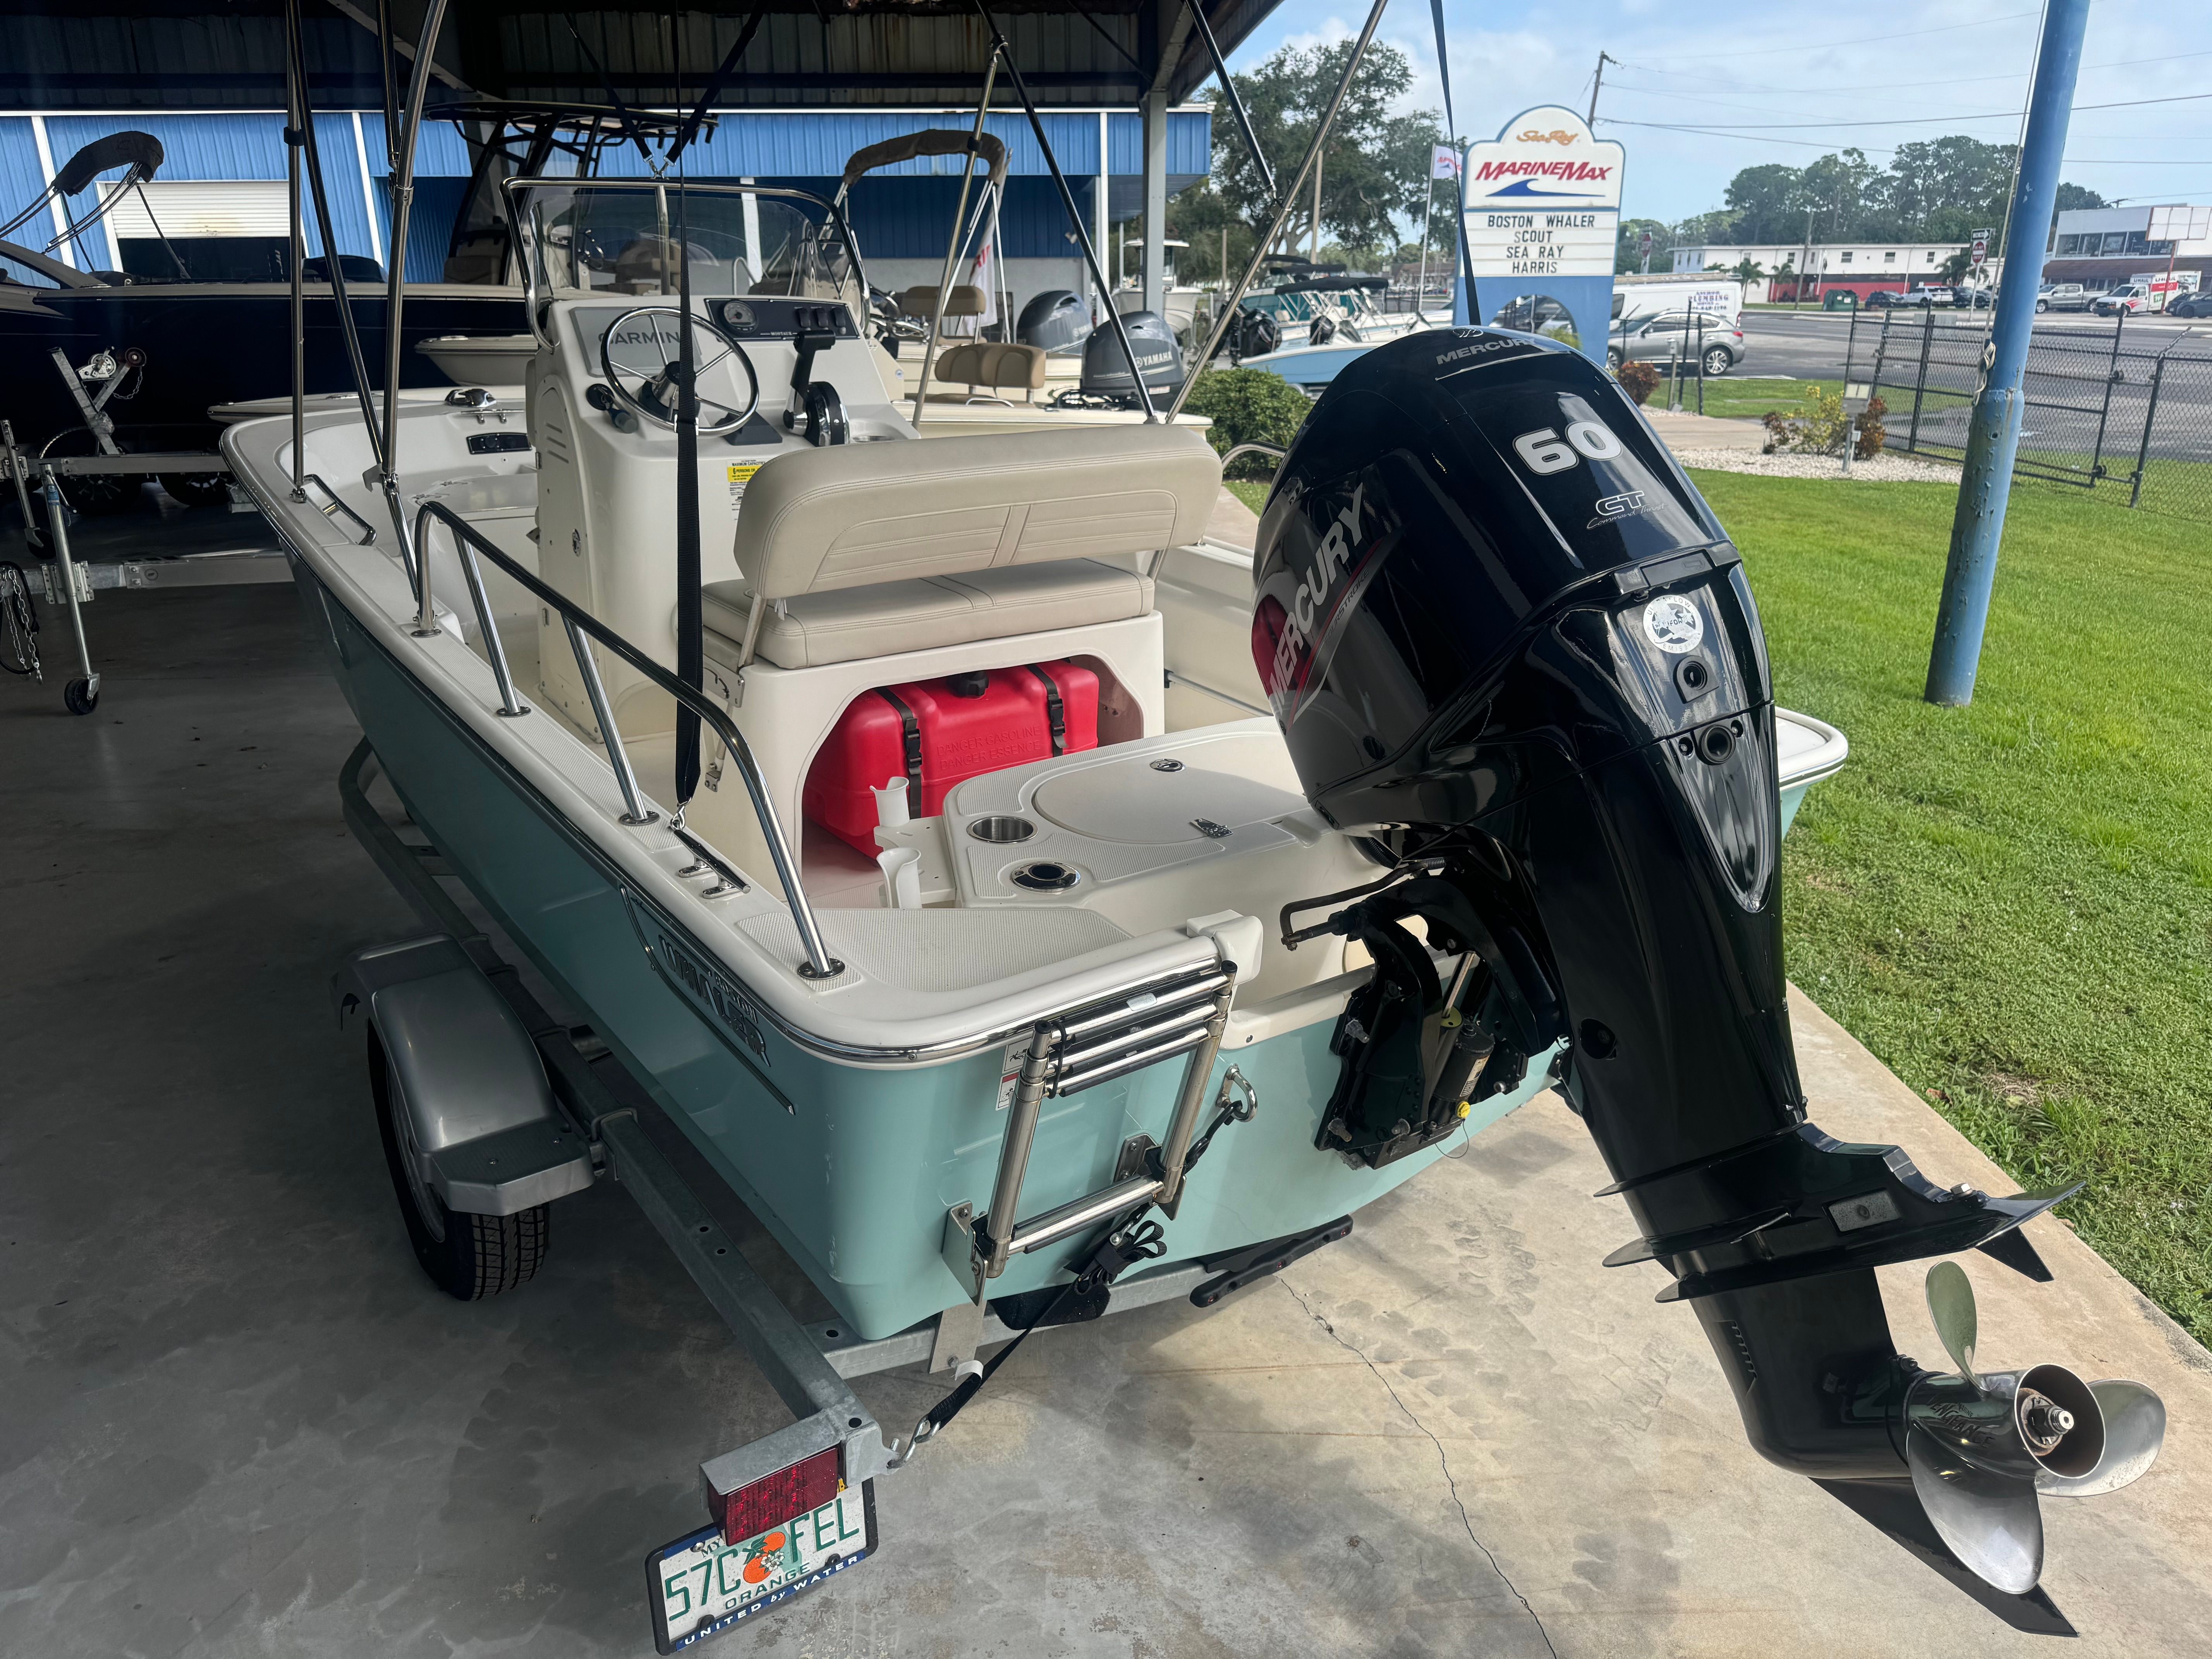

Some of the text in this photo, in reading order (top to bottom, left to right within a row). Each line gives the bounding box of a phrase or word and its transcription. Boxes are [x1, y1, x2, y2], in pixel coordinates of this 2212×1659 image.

[1488, 215, 1595, 228] BOSTON WHALER
[1514, 231, 1553, 243] SCOUT
[1506, 246, 1564, 258] SEA RAY
[1512, 261, 1557, 273] HARRIS
[1143, 351, 1173, 366] YAMAHA
[1436, 338, 1535, 364] MERCURY
[1513, 420, 1623, 475] 60
[1587, 503, 1665, 530] Command Thrust
[1595, 490, 1645, 516] CT
[1269, 482, 1364, 713] MERCURY
[937, 726, 1041, 756] DANGER GASOLINE
[940, 740, 1041, 771] DANGER ESSENCE
[659, 934, 771, 1067] WHALER
[1926, 1396, 1995, 1448] VENGEANCE
[1958, 1403, 1973, 1418] MARINE
[665, 1498, 859, 1621] 57C FEL
[725, 1562, 810, 1610] ORANGE
[684, 1556, 858, 1645] UNITED by WATER
